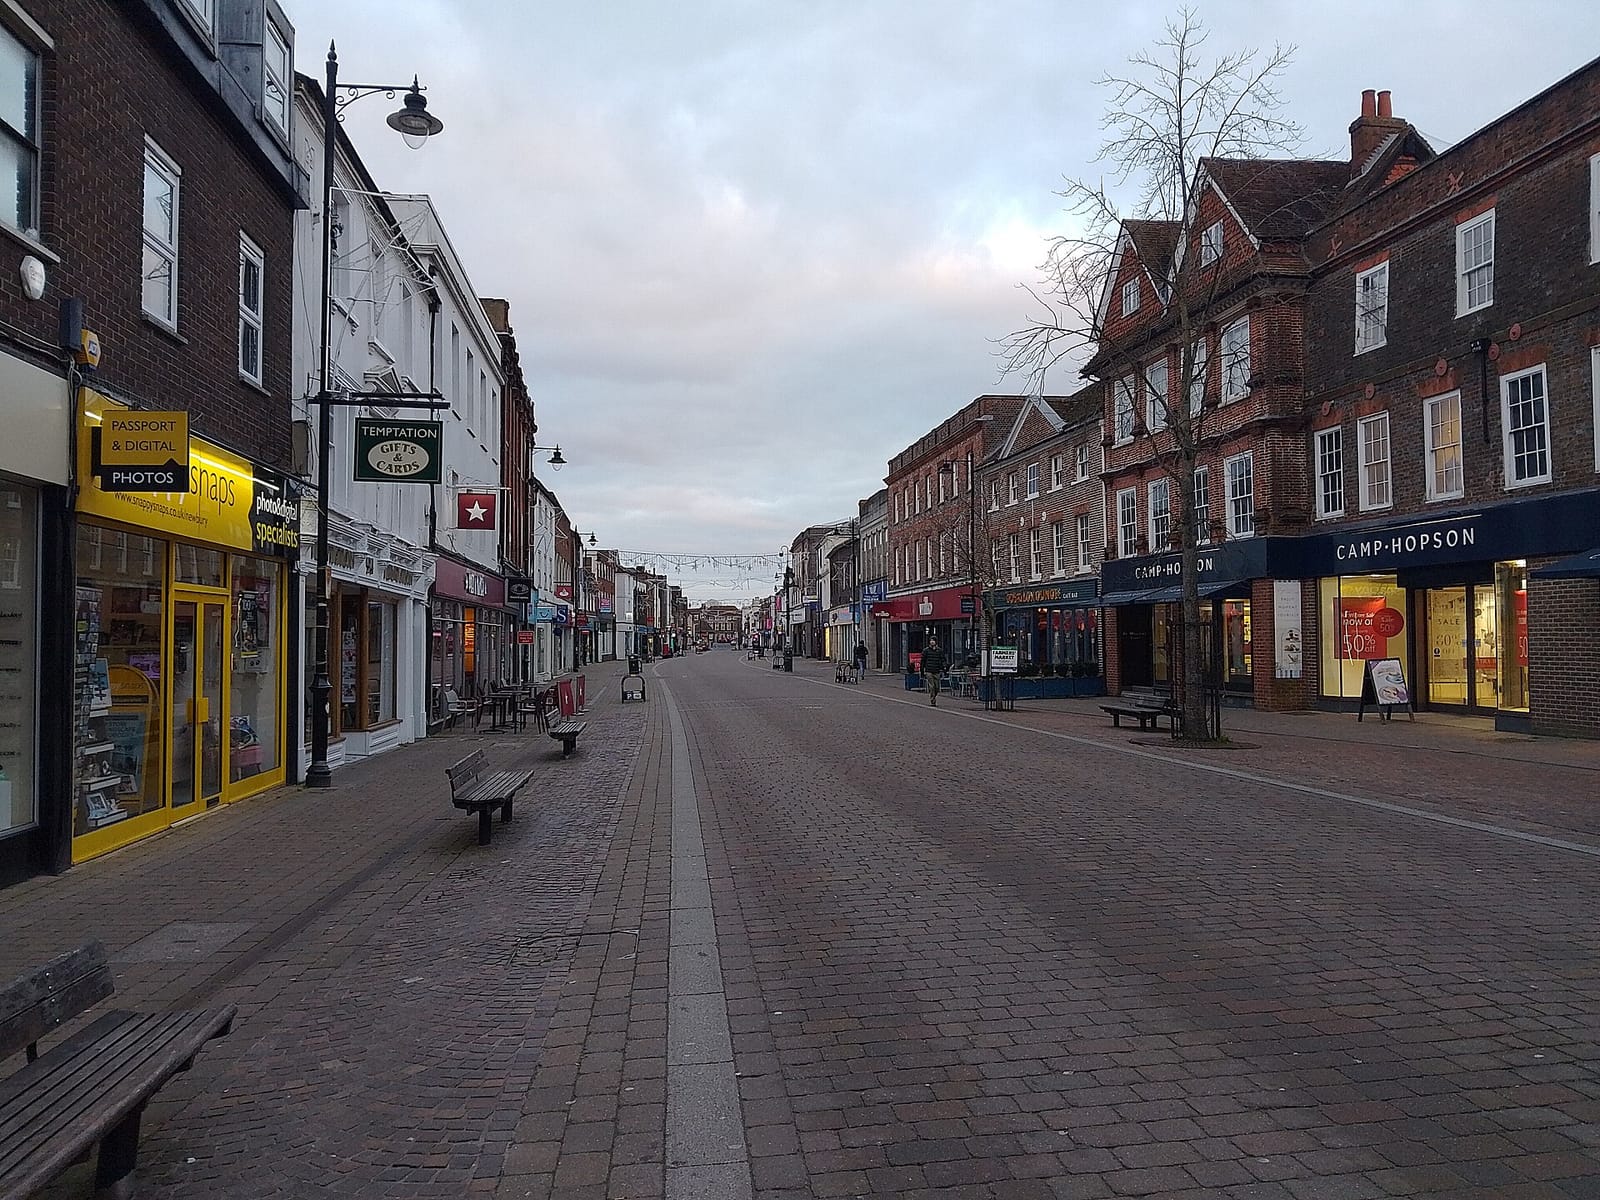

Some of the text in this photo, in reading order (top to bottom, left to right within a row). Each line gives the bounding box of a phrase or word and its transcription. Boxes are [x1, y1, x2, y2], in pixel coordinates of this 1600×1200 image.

[111, 420, 177, 432] PASSPORT
[361, 426, 438, 439] TEMPTATION
[111, 440, 177, 452] & DIGITAL
[380, 443, 417, 455] GIFTS
[392, 453, 403, 462] &
[376, 460, 420, 474] CARDS
[112, 471, 175, 484] PHOTOS
[190, 464, 236, 516] snaps
[256, 491, 298, 524] photo&digital
[256, 521, 299, 548] specialists
[1438, 618, 1461, 626] SALE
[1343, 634, 1376, 653] 50%
